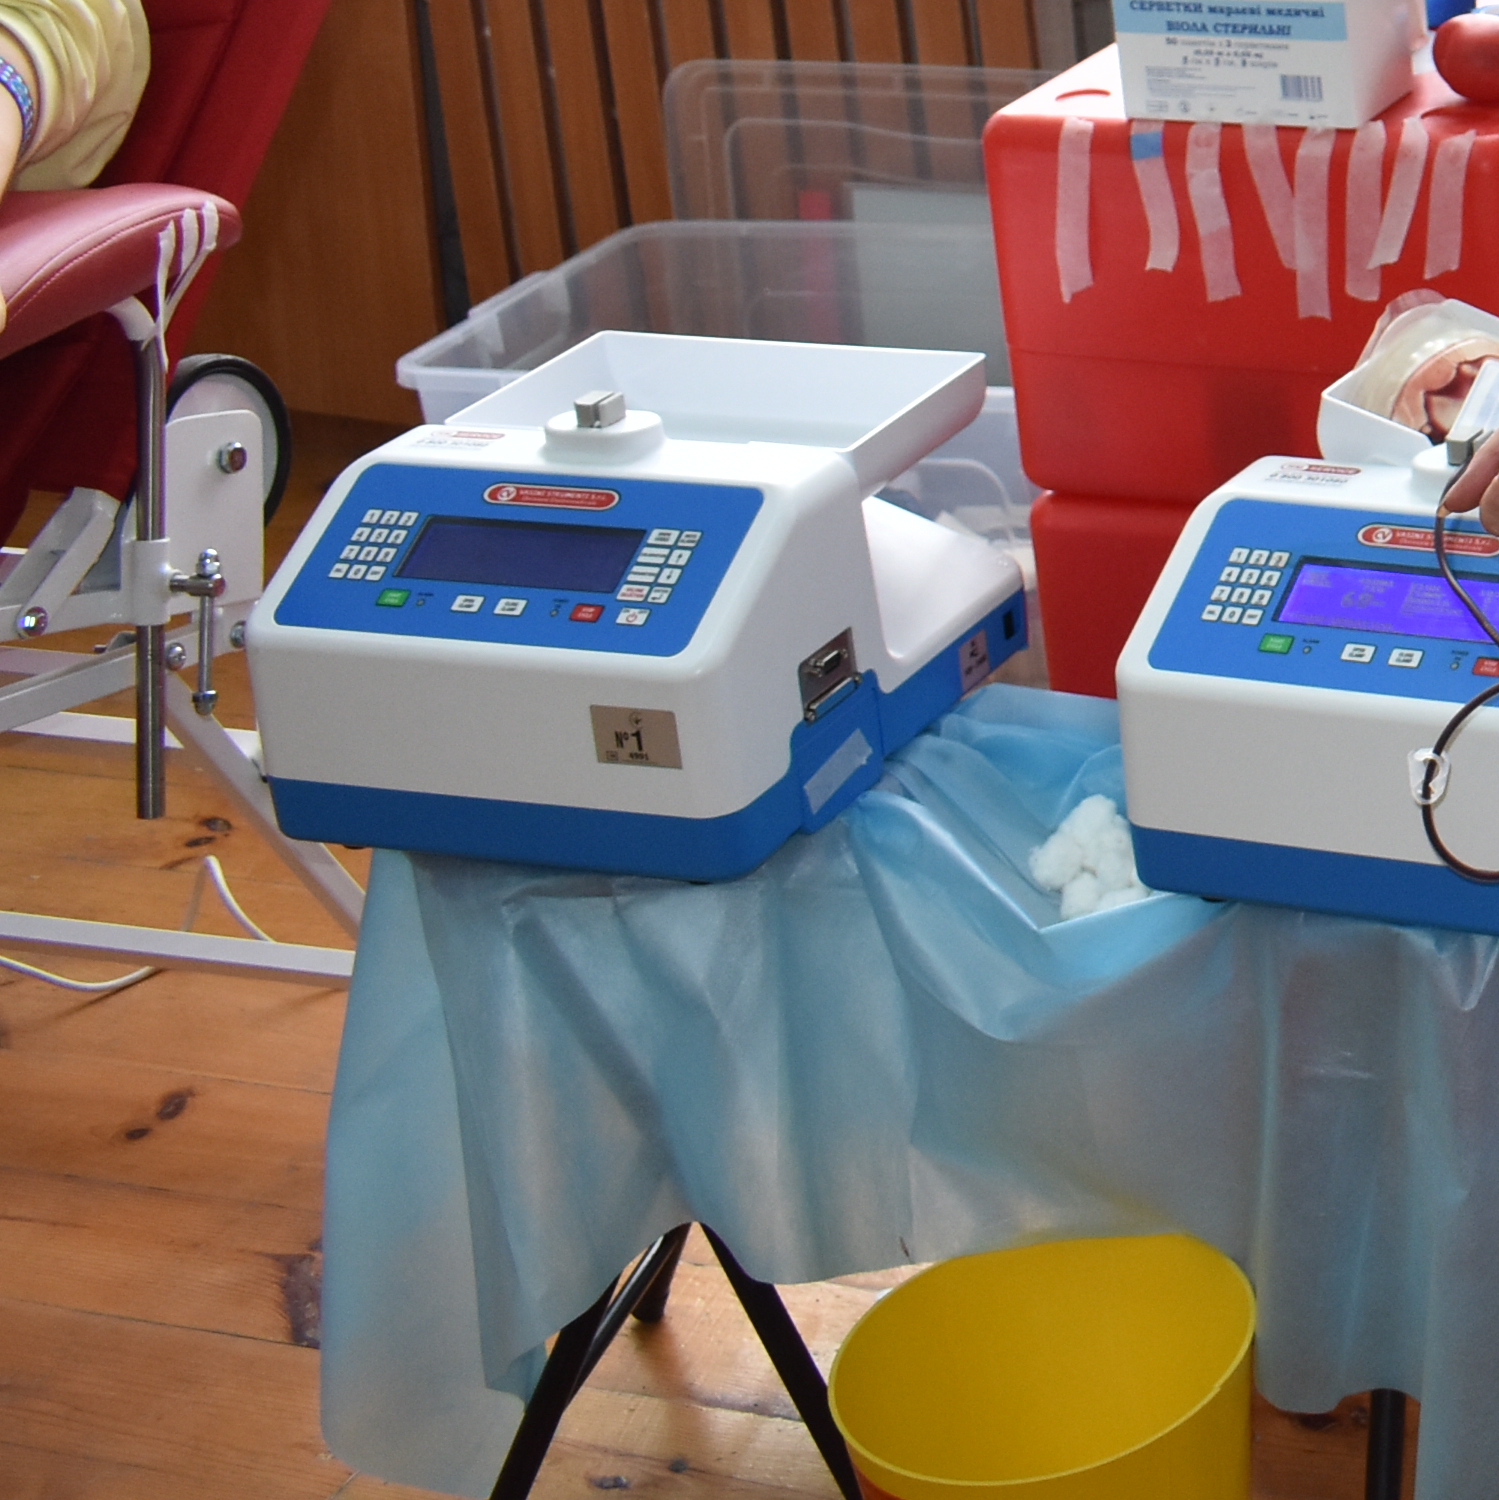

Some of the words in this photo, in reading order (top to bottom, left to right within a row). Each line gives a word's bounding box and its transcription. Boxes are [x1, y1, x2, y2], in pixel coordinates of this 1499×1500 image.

[1130, 0, 1203, 14] СЕРВЕТКИ
[1266, 7, 1325, 18] медичні
[1166, 20, 1209, 33] ВІОЛА
[1213, 22, 1292, 36] СТЕРИЛЬНІ
[631, 729, 643, 751] 1
